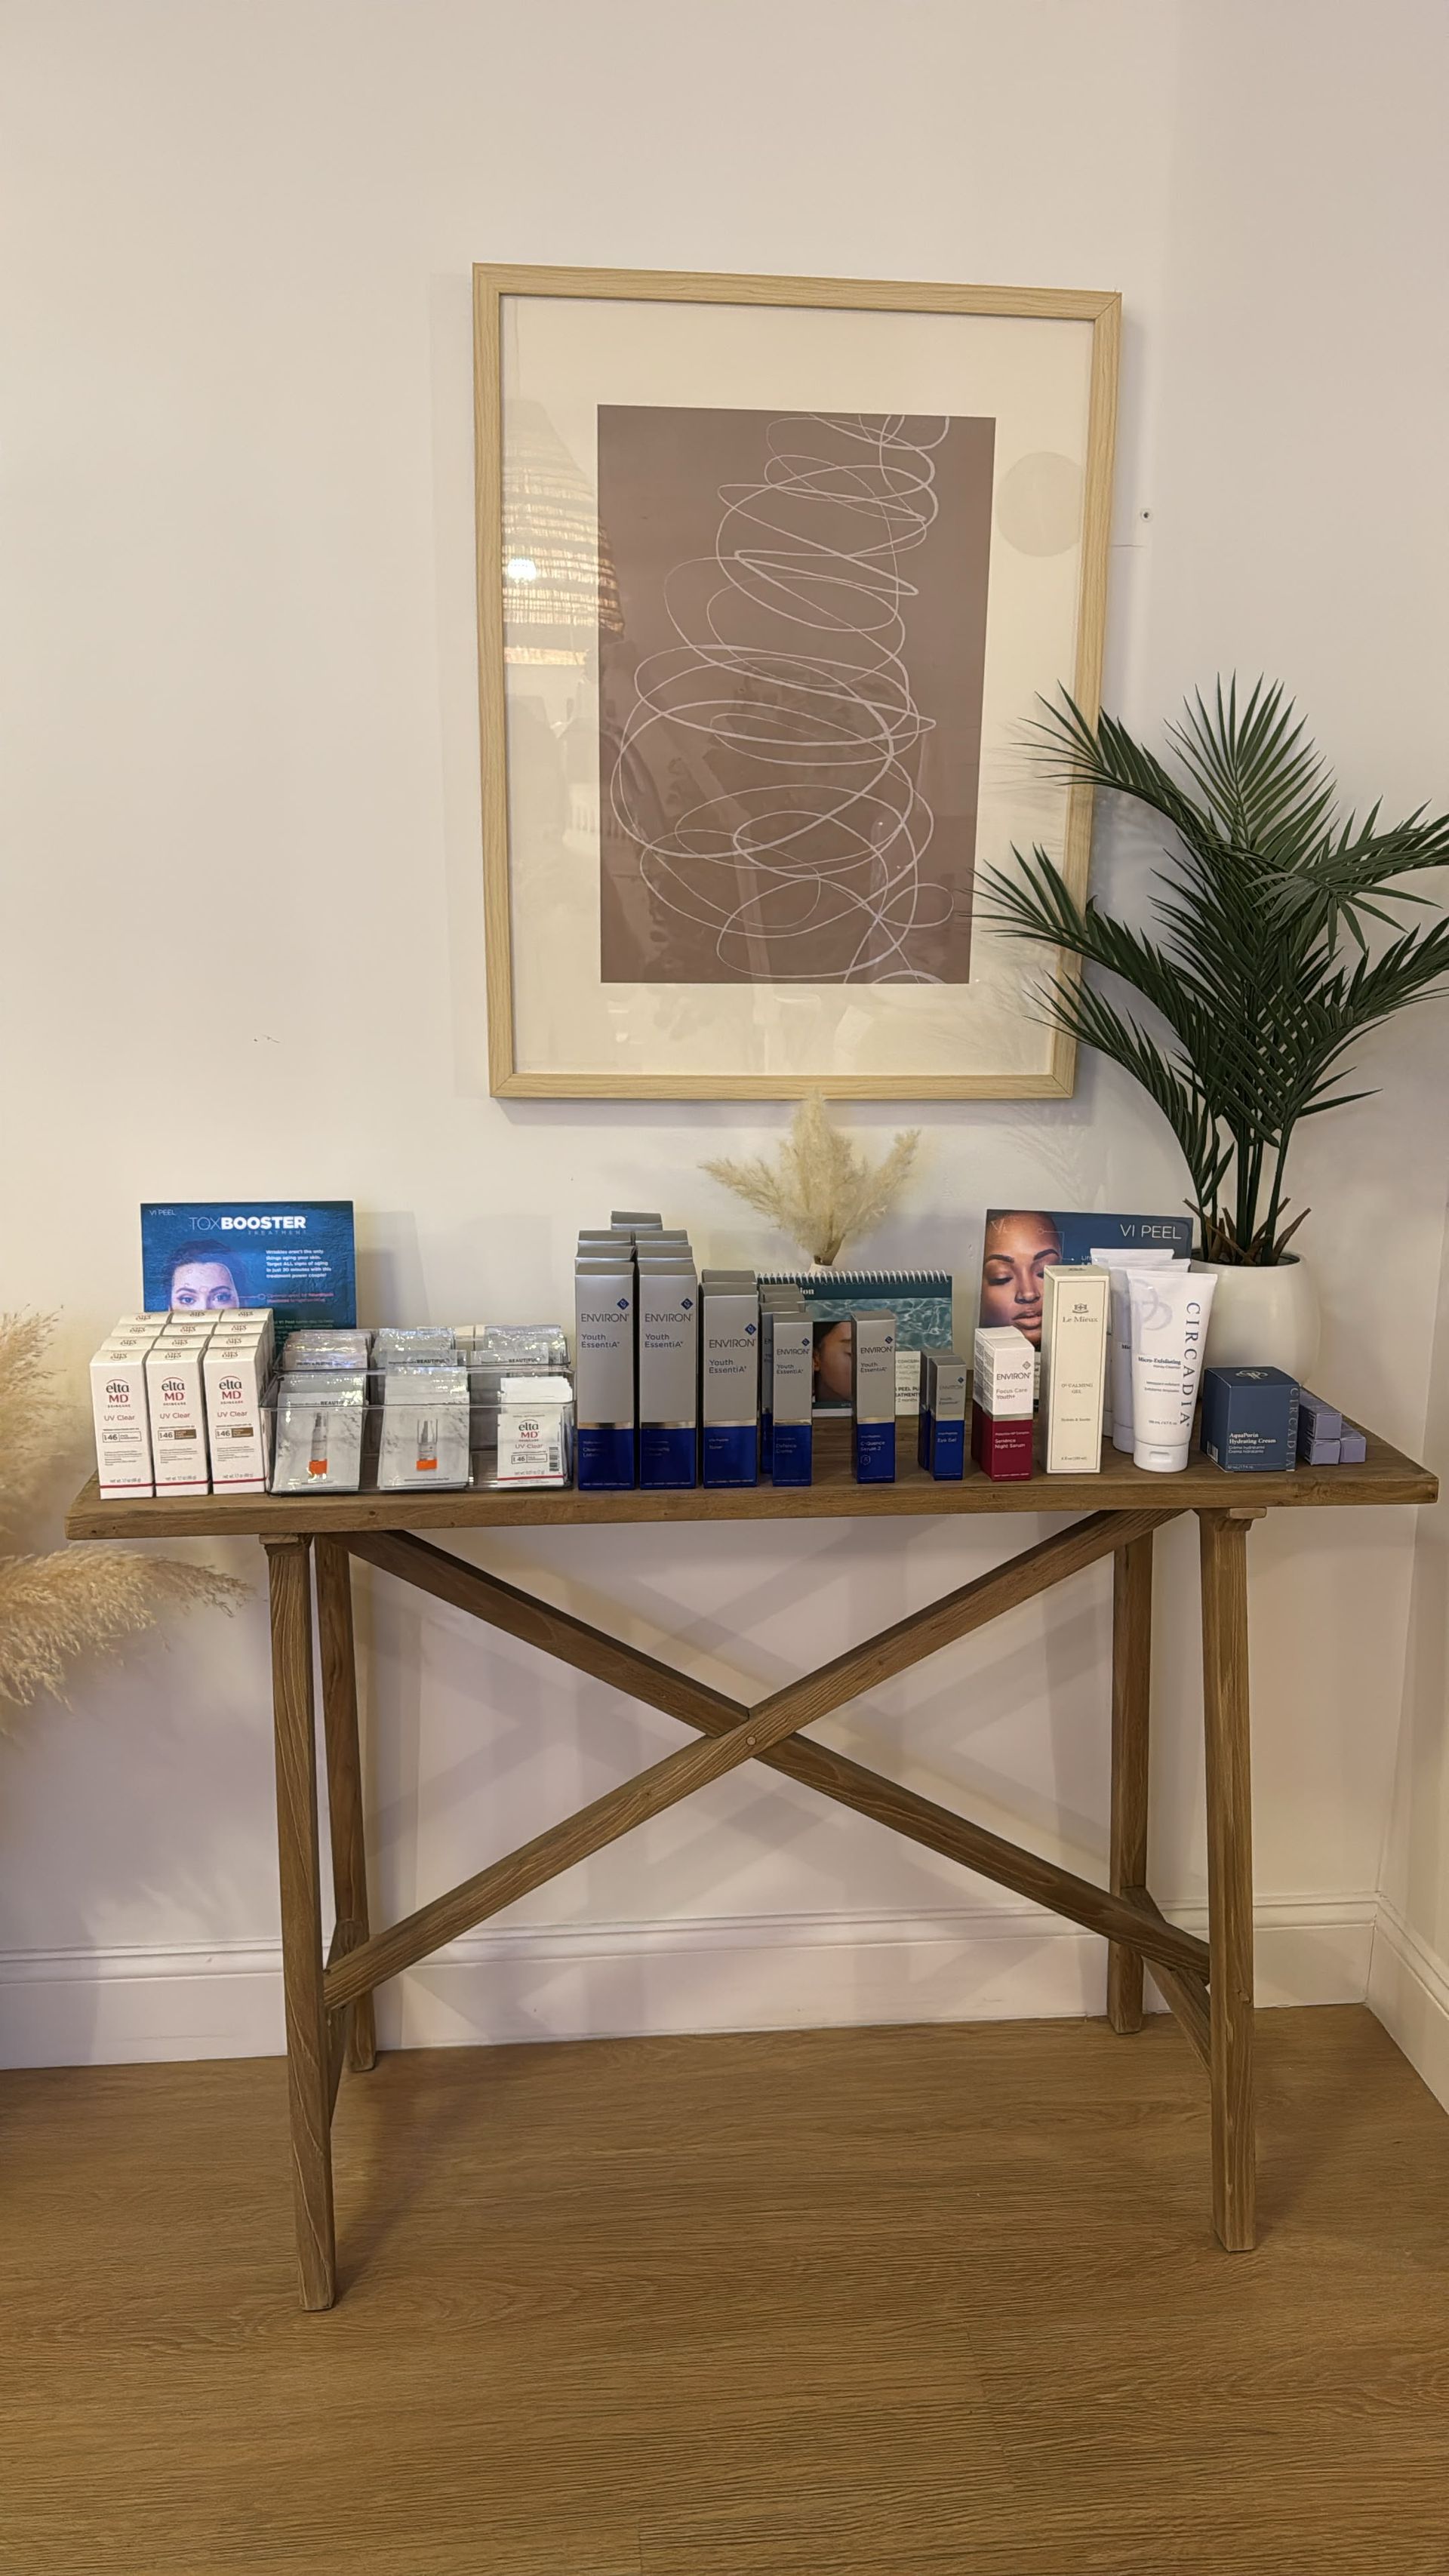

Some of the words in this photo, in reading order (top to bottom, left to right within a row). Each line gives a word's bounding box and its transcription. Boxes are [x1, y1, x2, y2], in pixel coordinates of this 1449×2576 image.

[189, 1216, 306, 1230] TOXBOOSTER
[1120, 1223, 1135, 1237] VI
[1141, 1225, 1182, 1239] PEEL
[581, 1313, 628, 1322] ENVIRON
[645, 1313, 691, 1322] ENVIRON
[709, 1339, 755, 1349] ENVIRON
[860, 1346, 892, 1354] ENVIRON
[1180, 1302, 1201, 1425] CIRCADIA
[997, 1372, 1029, 1380] ENVIRON
[106, 1383, 130, 1393] elta
[162, 1380, 185, 1392] elta
[219, 1379, 242, 1390] elta
[109, 1394, 129, 1403] MD
[165, 1393, 184, 1402] MD
[222, 1390, 242, 1400] MD
[518, 1422, 539, 1431] elta
